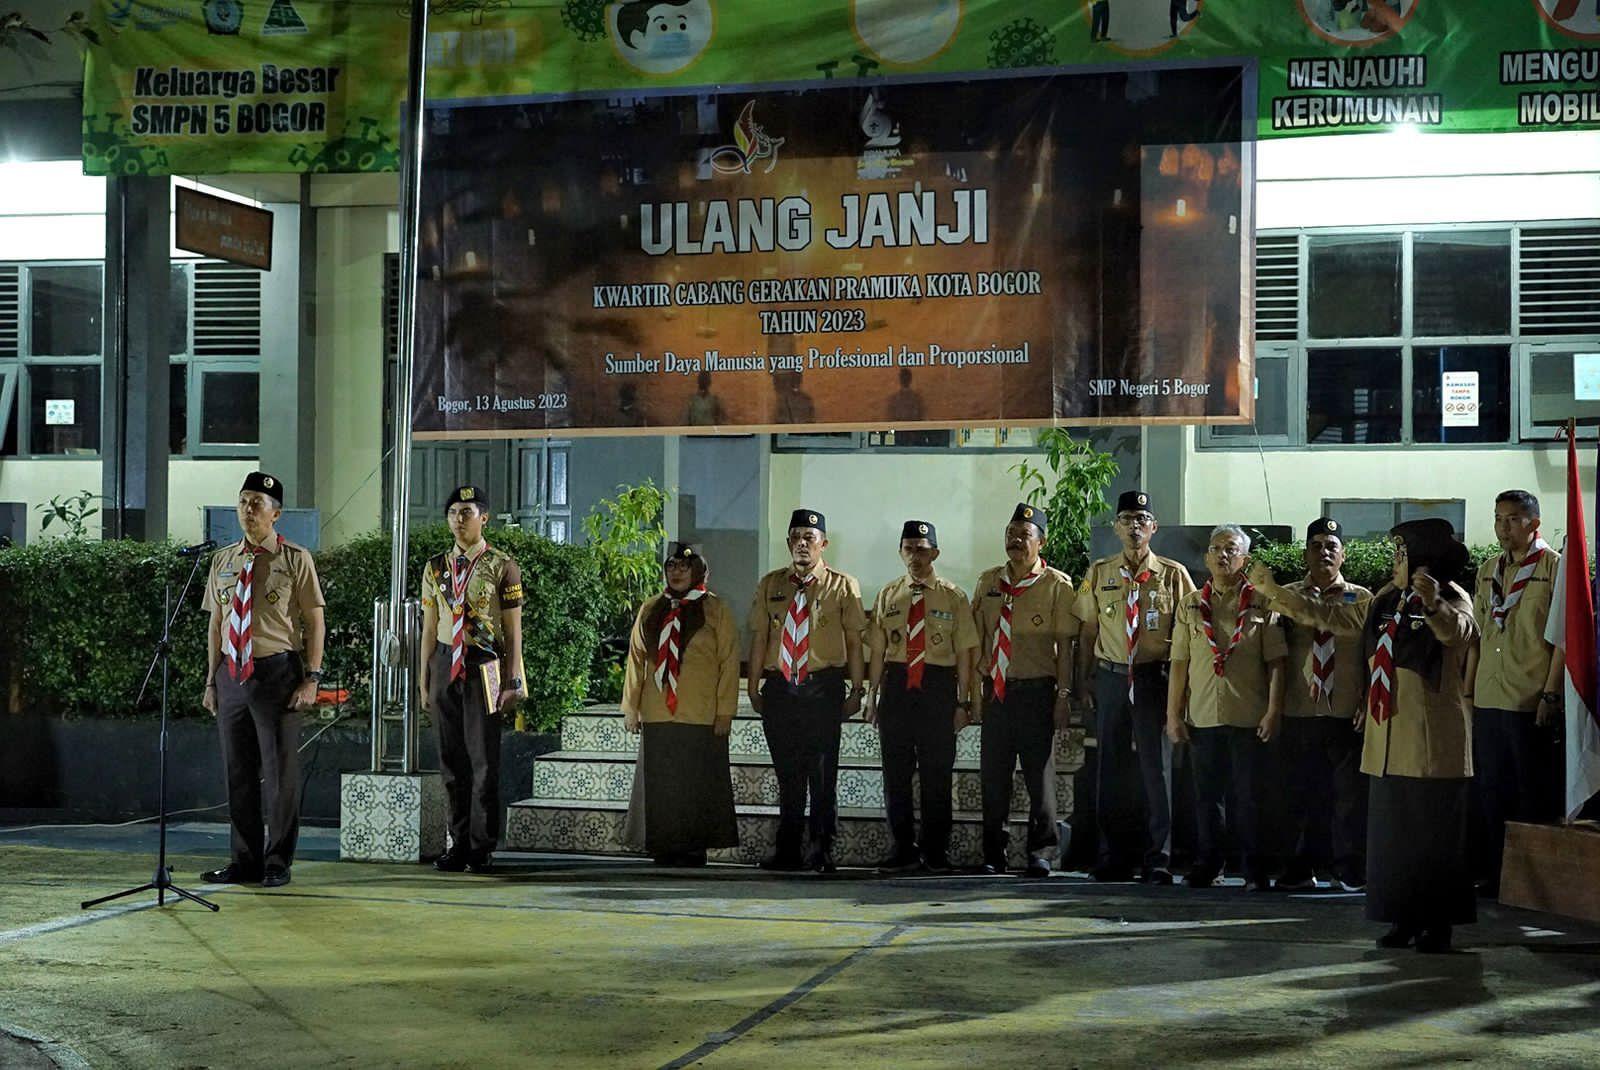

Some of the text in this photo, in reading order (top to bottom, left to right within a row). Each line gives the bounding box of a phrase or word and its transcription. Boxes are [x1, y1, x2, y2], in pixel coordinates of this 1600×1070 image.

[135, 64, 340, 98] Keluarga Besar
[1289, 56, 1425, 88] MENJAUHI
[1502, 51, 1599, 82] MENGU
[132, 101, 326, 136] SMPN 5 BOGOR
[1274, 95, 1441, 128] KERUMUNAN
[1520, 92, 1600, 123] MOBIL
[639, 188, 989, 256] ULANG JANJI
[592, 271, 1041, 309] KWARTIR CABANG GERAKAN PRAMUKA KOTA BOGOR
[760, 309, 865, 335] TAHUN 2023
[605, 342, 1030, 375] Sumber Daya Manusia yang Profesional dan Proporsional
[437, 393, 567, 414] Bogor, 13 Agustus 2023
[1088, 378, 1211, 398] SMP Negeri 5 Bogor
